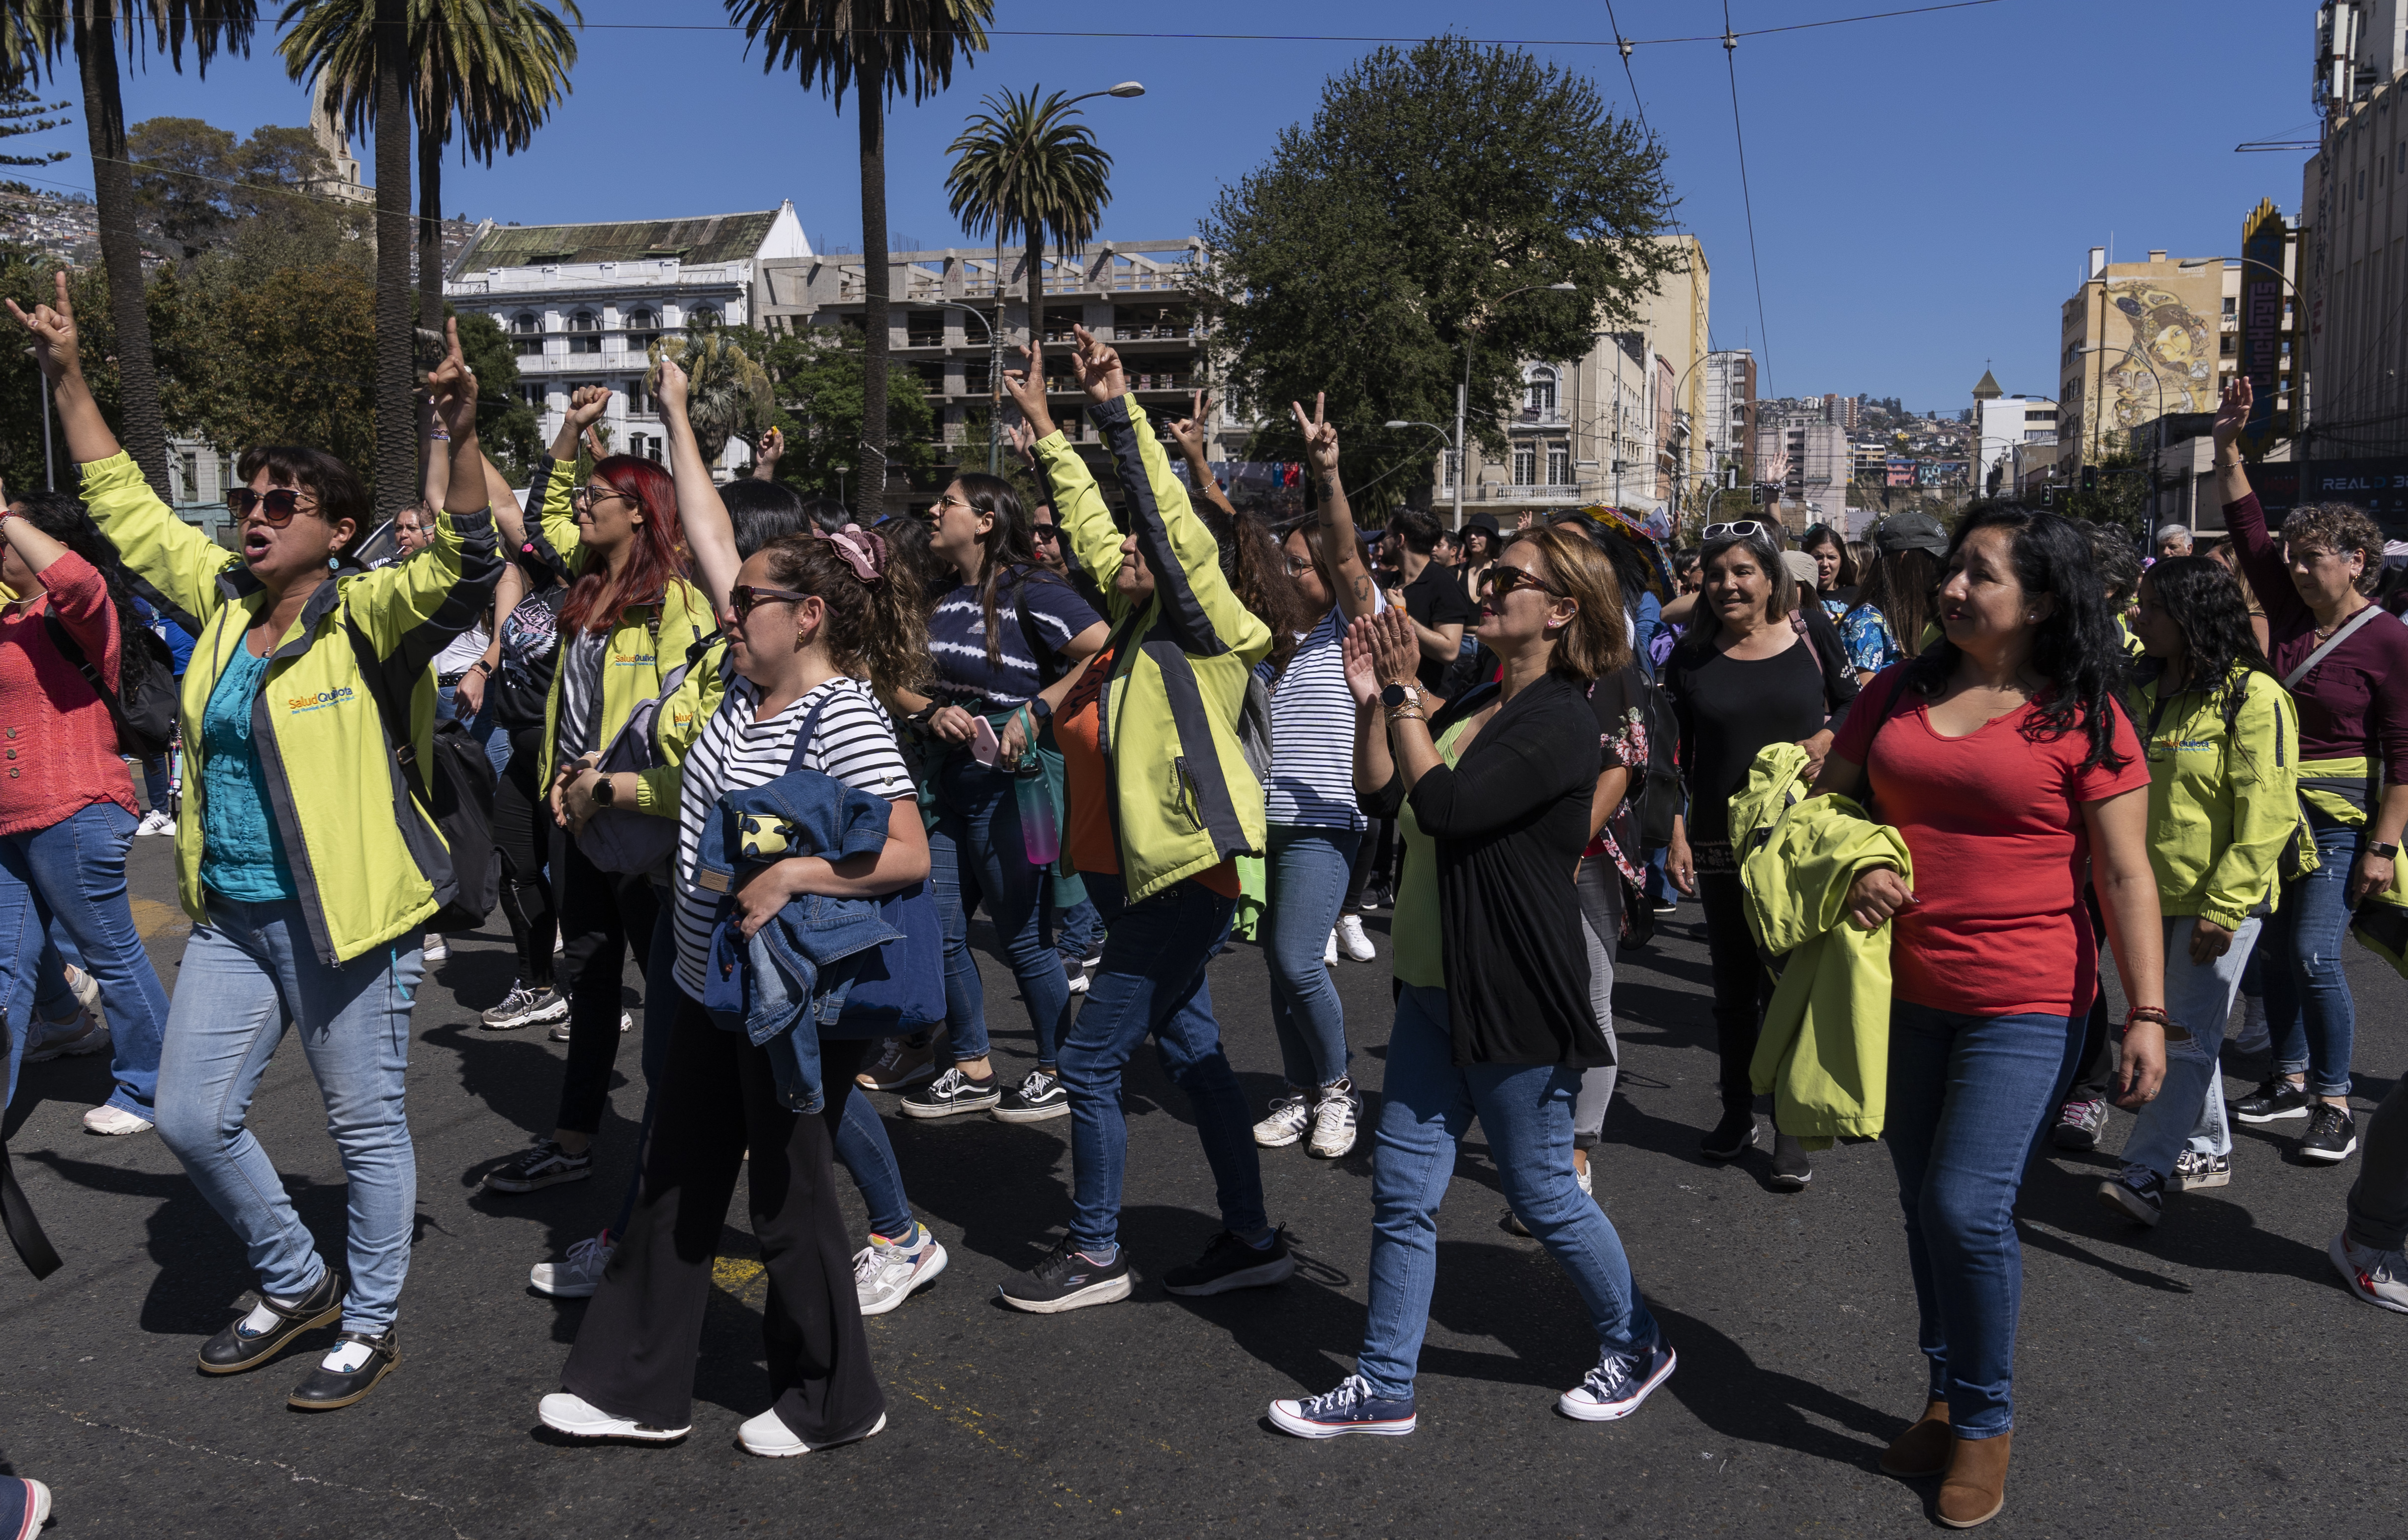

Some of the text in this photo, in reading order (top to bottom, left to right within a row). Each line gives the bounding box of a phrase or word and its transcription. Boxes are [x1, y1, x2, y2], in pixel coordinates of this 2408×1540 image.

[2264, 476, 2300, 495] Hoyt
[2322, 475, 2408, 490] REAL D 3
